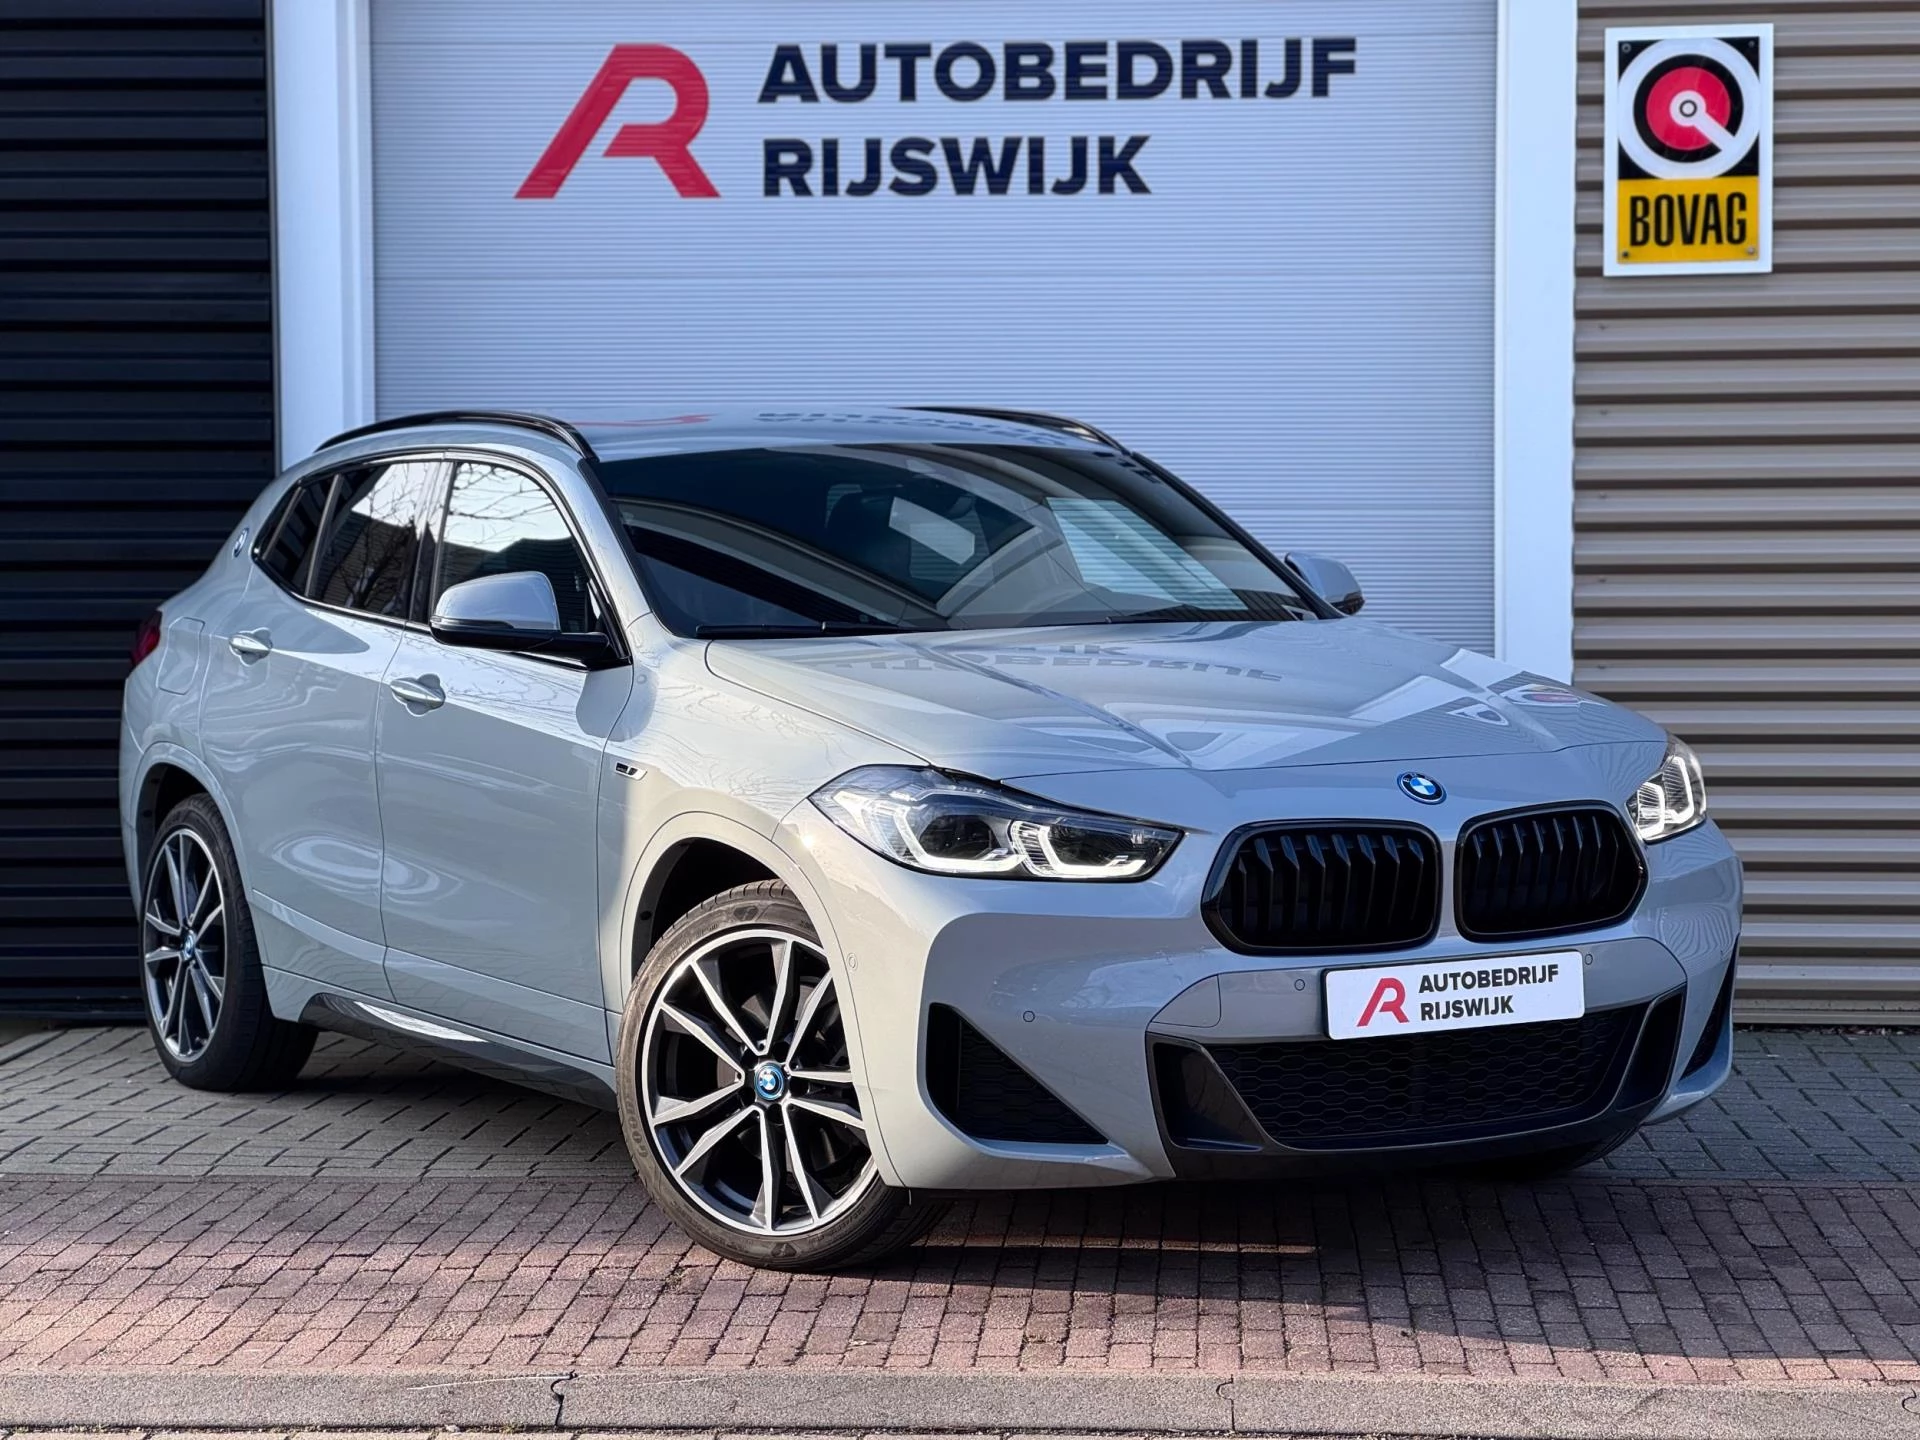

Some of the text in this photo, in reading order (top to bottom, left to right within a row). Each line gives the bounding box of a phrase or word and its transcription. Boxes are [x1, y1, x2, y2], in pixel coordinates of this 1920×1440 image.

[758, 38, 1357, 103] AUTOBEDRIJF
[764, 136, 1152, 197] RIJSWIJK
[1629, 191, 1748, 247] BOVAG
[1418, 964, 1559, 994] AUTOBEDRIJF
[1420, 995, 1514, 1021] RIJSWIJK
